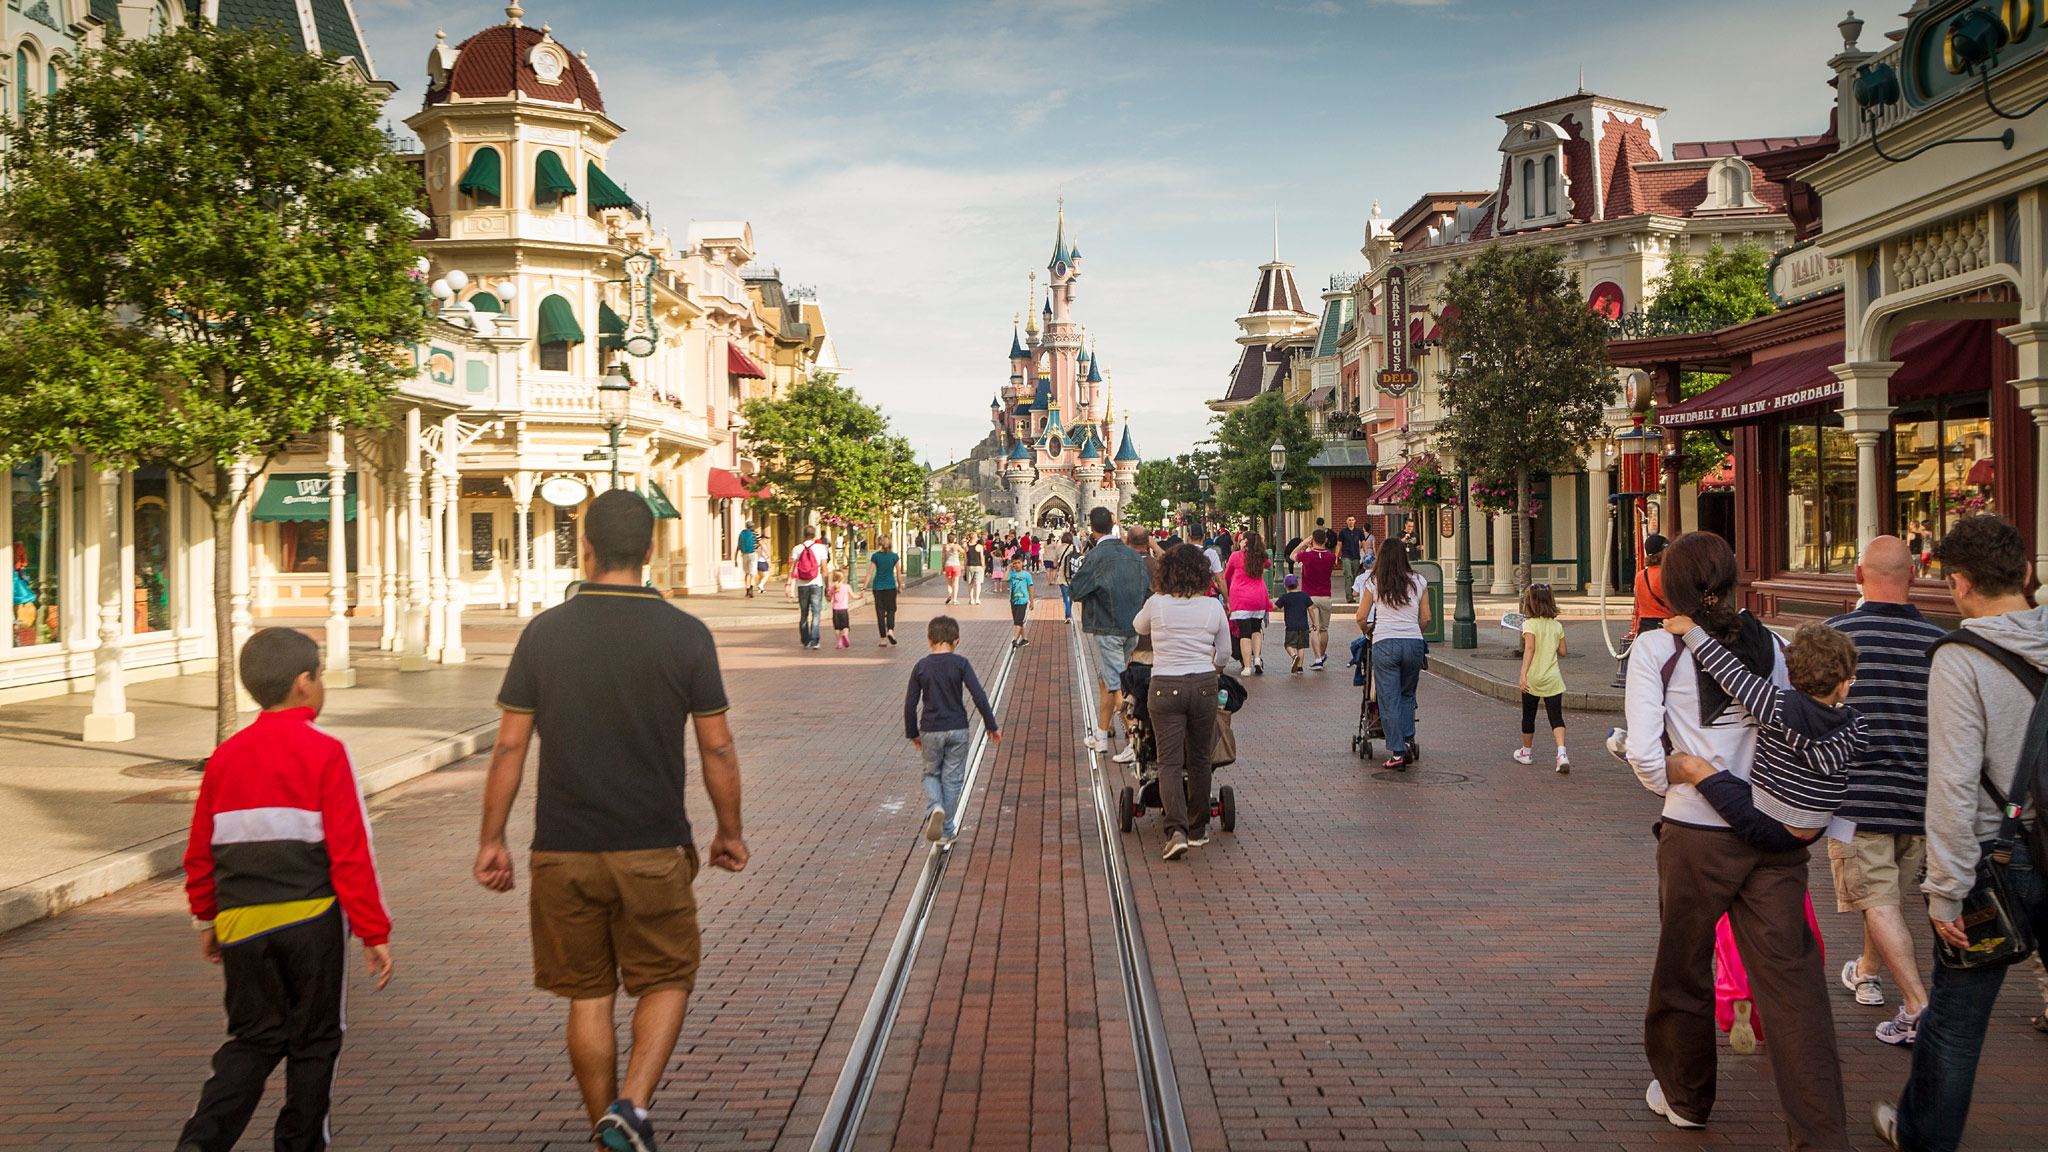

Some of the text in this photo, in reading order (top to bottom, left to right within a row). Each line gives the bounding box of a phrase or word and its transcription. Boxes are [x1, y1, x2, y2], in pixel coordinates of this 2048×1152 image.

[1792, 252, 1824, 286] MAIN
[1390, 276, 1402, 372] MARKET HOUSE
[1383, 373, 1412, 383] DELI
[1659, 382, 1844, 425] DEPENDABLE ALL NEW AFFORDABLE
